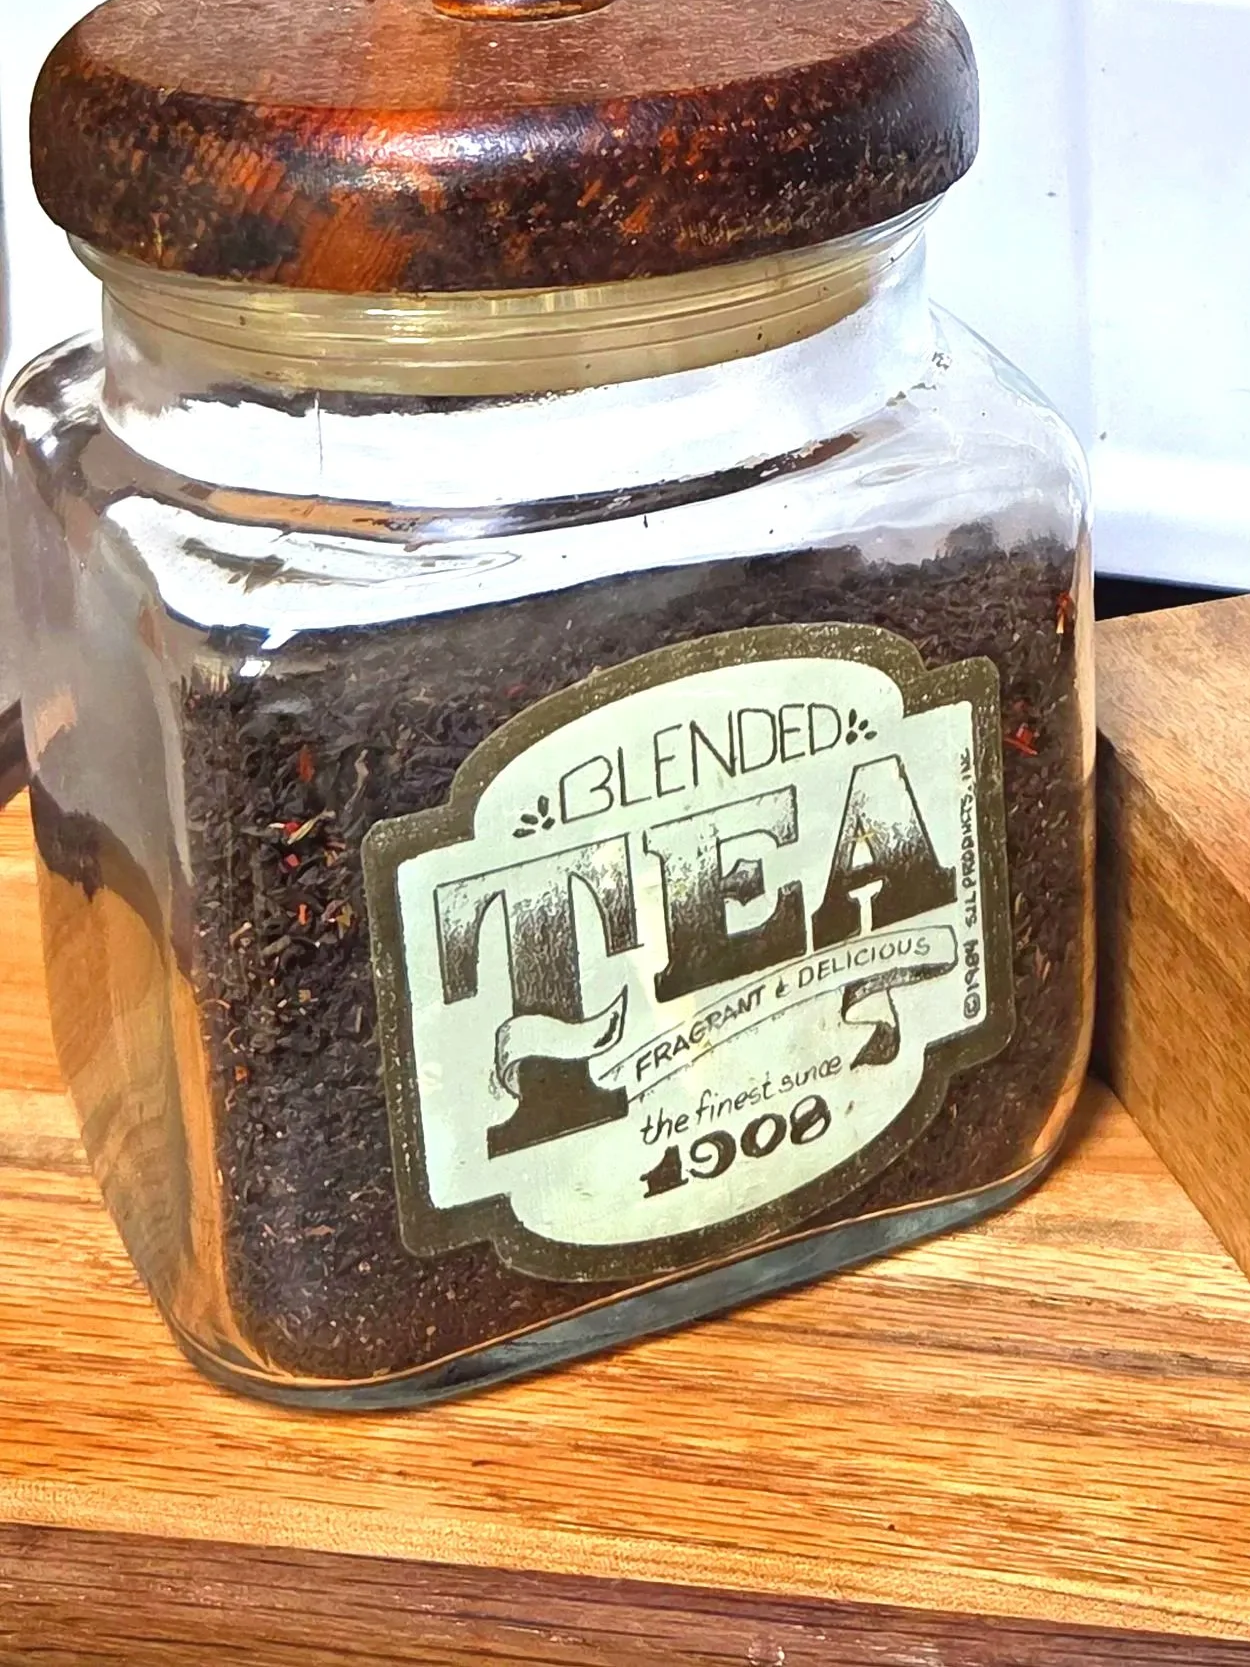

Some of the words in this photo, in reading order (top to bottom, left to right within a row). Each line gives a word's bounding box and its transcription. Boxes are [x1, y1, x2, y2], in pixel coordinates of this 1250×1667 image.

[558, 701, 843, 824] BLENDED
[433, 753, 958, 1161] TEA
[636, 984, 766, 1082] FRAGRANT
[797, 936, 932, 989] DELICIOUS
[638, 1094, 832, 1199] 1908
[639, 1106, 691, 1146] the
[695, 1078, 772, 1126] finest
[778, 1054, 843, 1094] since
